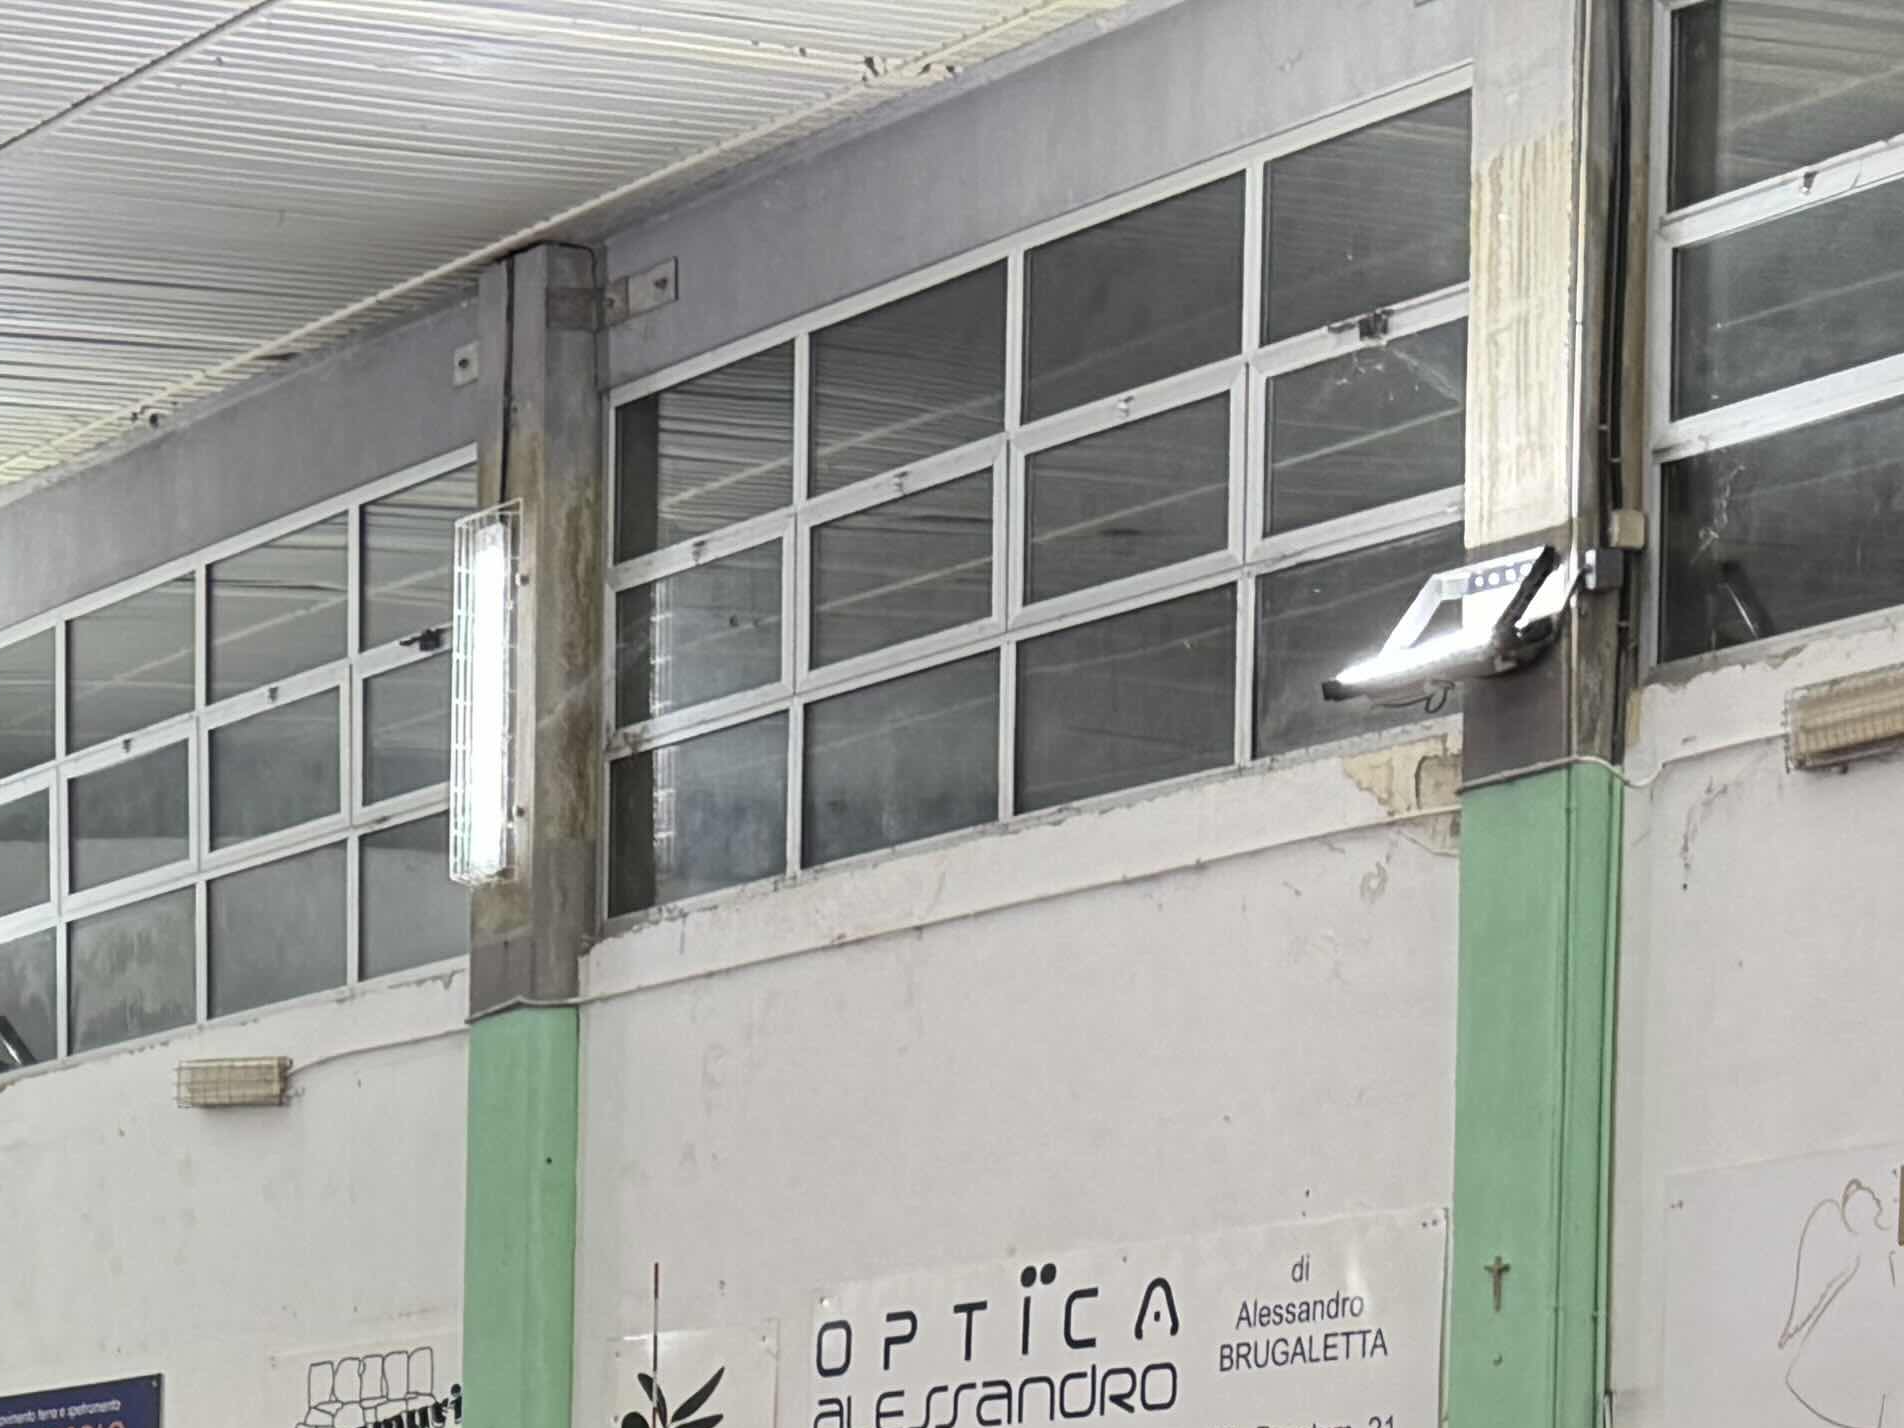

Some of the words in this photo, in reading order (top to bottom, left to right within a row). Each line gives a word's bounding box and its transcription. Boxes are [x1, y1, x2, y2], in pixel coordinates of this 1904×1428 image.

[1291, 1254, 1311, 1283] di
[1235, 1291, 1365, 1330] Alessandro
[1219, 1328, 1389, 1372] BRUGALETTA
